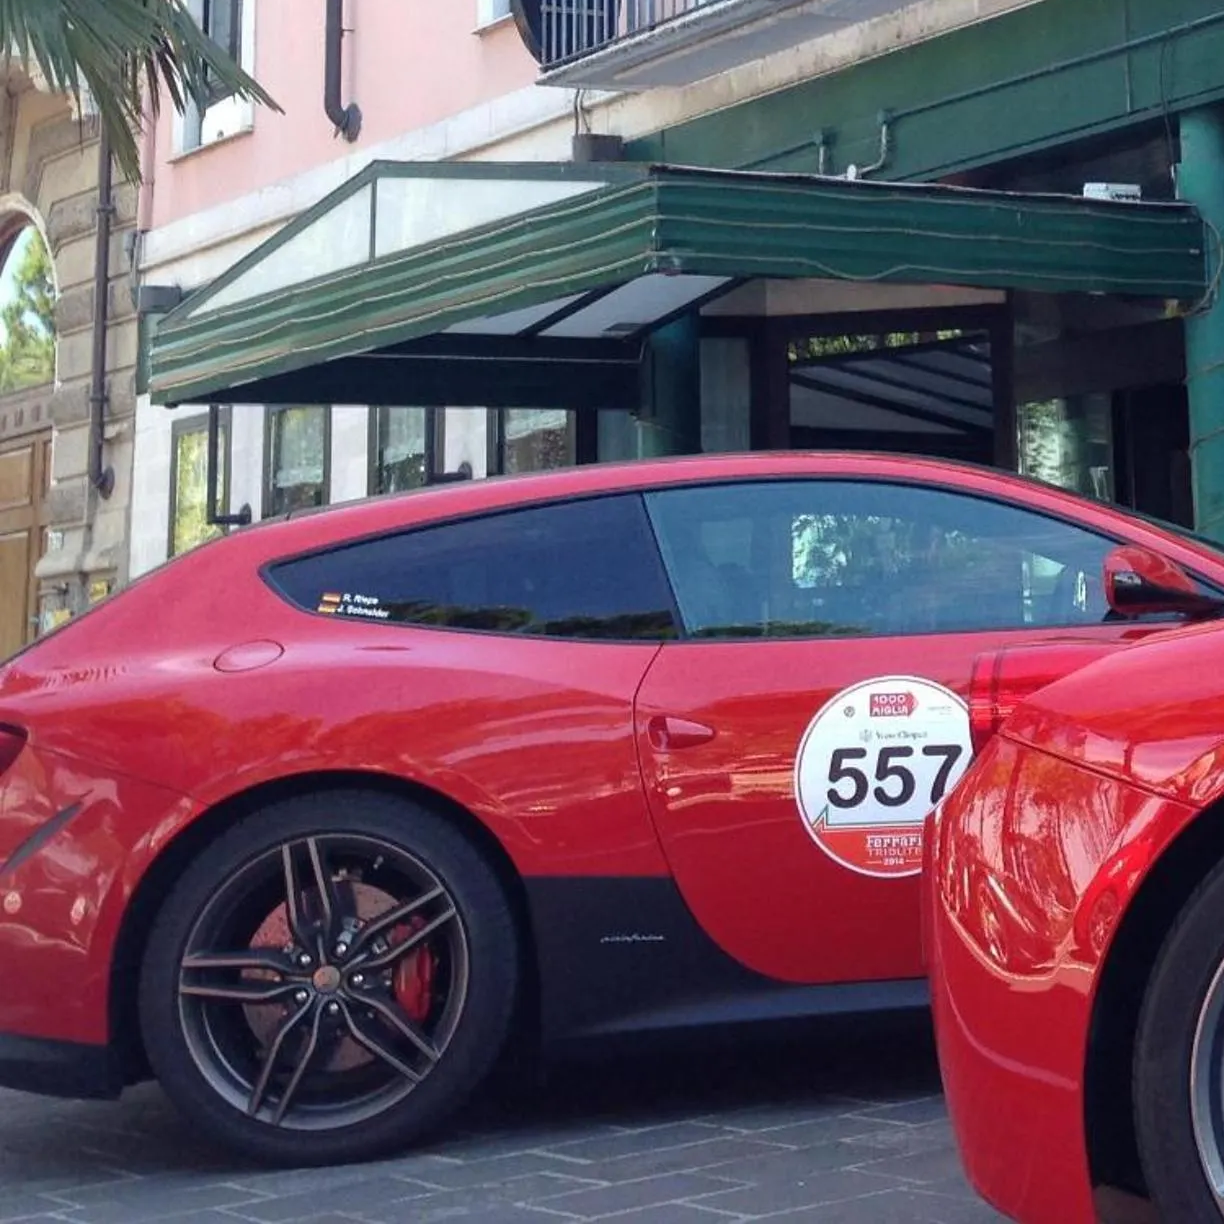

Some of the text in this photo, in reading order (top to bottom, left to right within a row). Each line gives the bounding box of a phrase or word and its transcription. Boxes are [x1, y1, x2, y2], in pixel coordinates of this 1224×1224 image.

[873, 694, 907, 705] 1000
[872, 705, 909, 715] MIGLIA
[827, 744, 963, 809] 557
